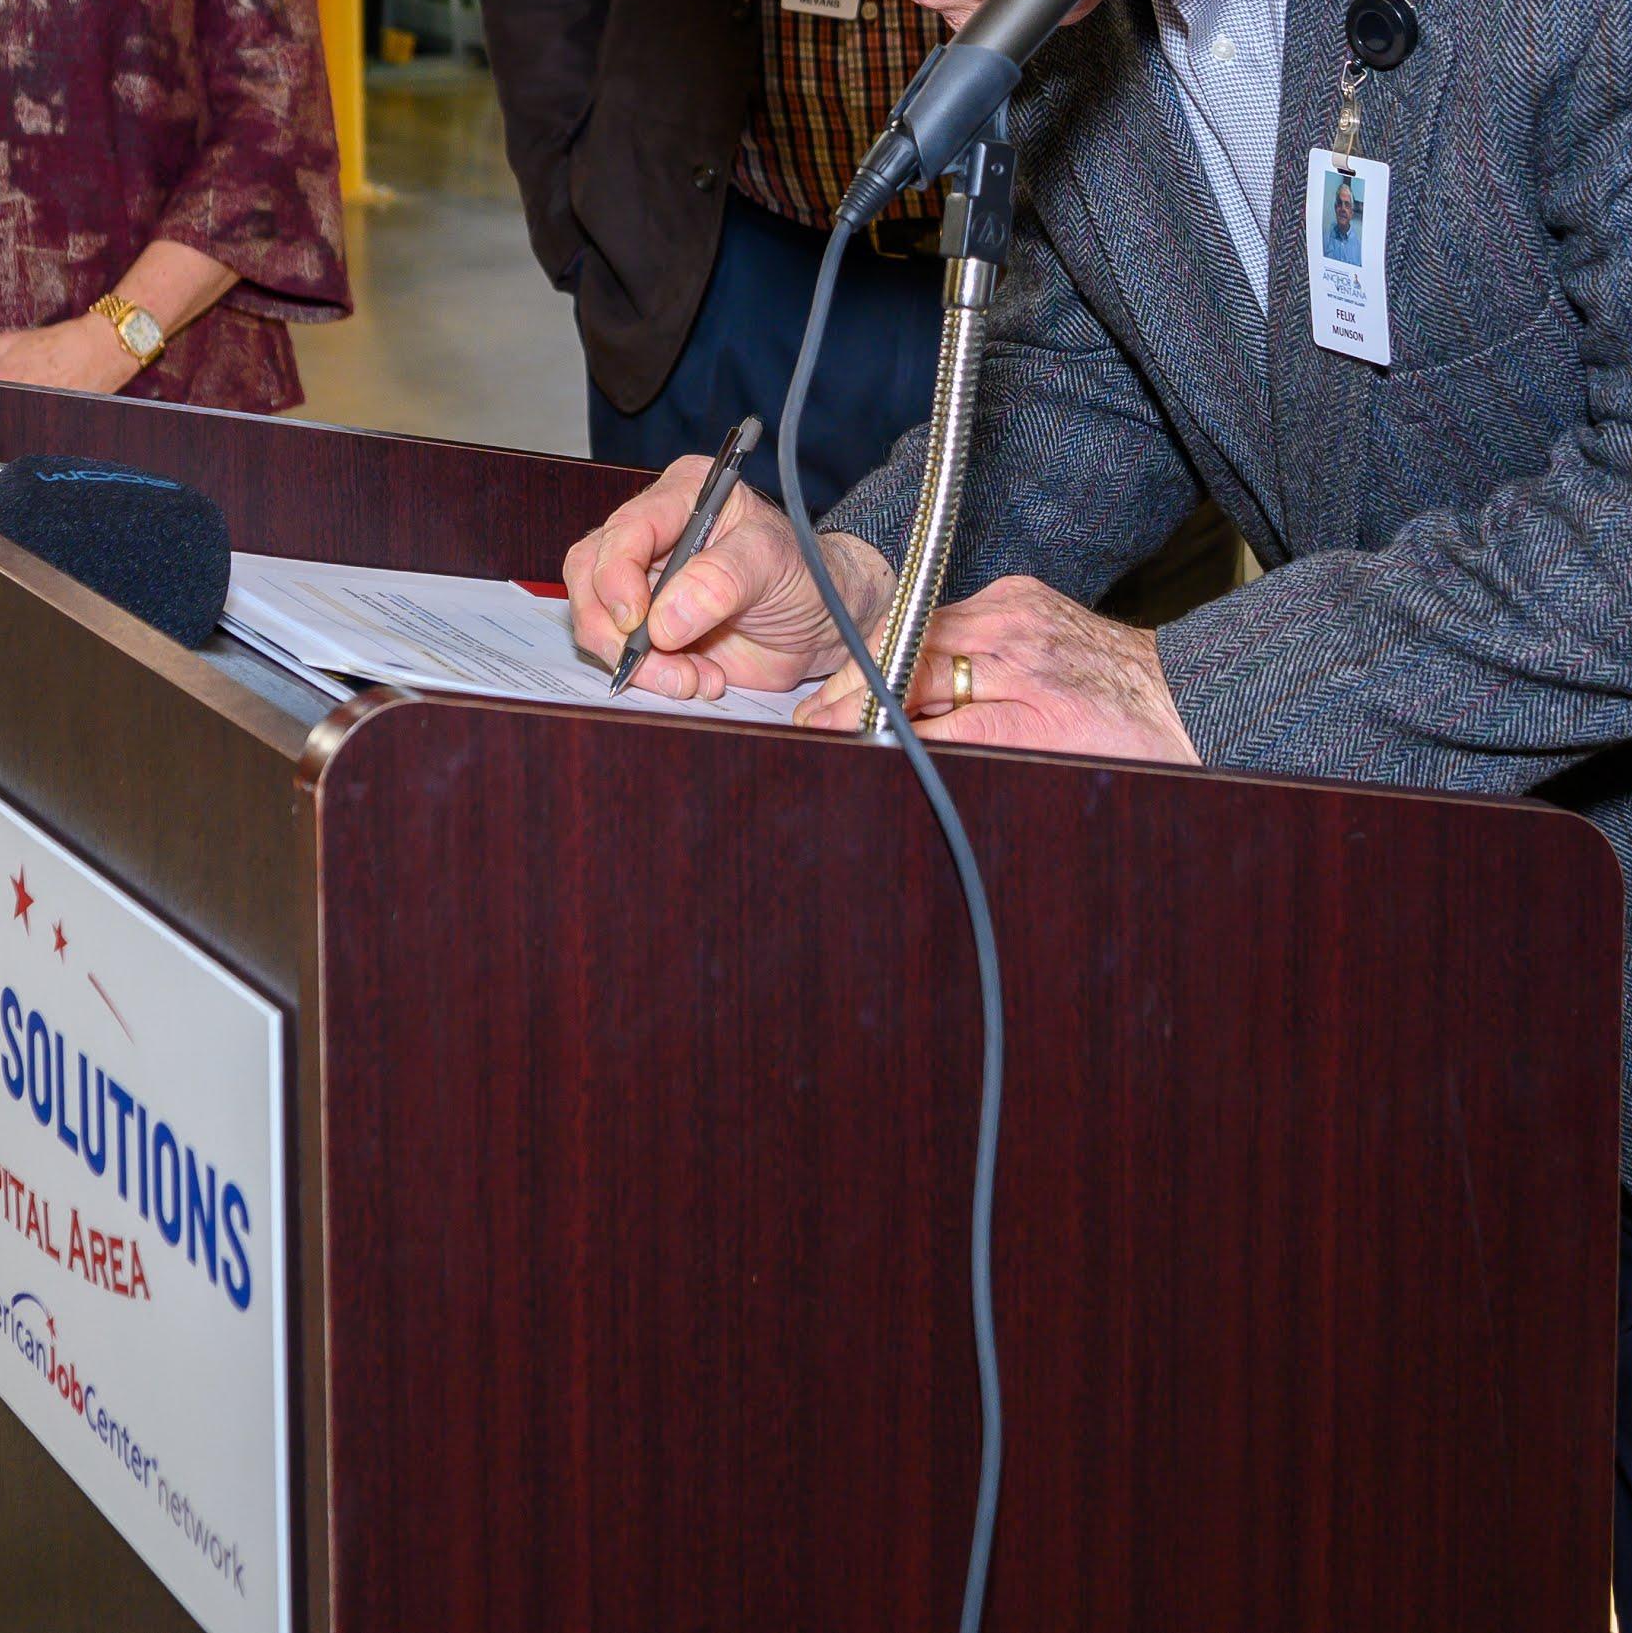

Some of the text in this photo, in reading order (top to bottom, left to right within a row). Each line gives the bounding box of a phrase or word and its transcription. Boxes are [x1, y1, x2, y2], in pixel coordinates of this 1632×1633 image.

[1332, 324, 1364, 343] MUNSON
[1336, 308, 1356, 323] FELIX
[0, 986, 251, 1312] SOLUTIONS
[67, 1206, 151, 1301] AREA
[157, 1474, 247, 1600] network
